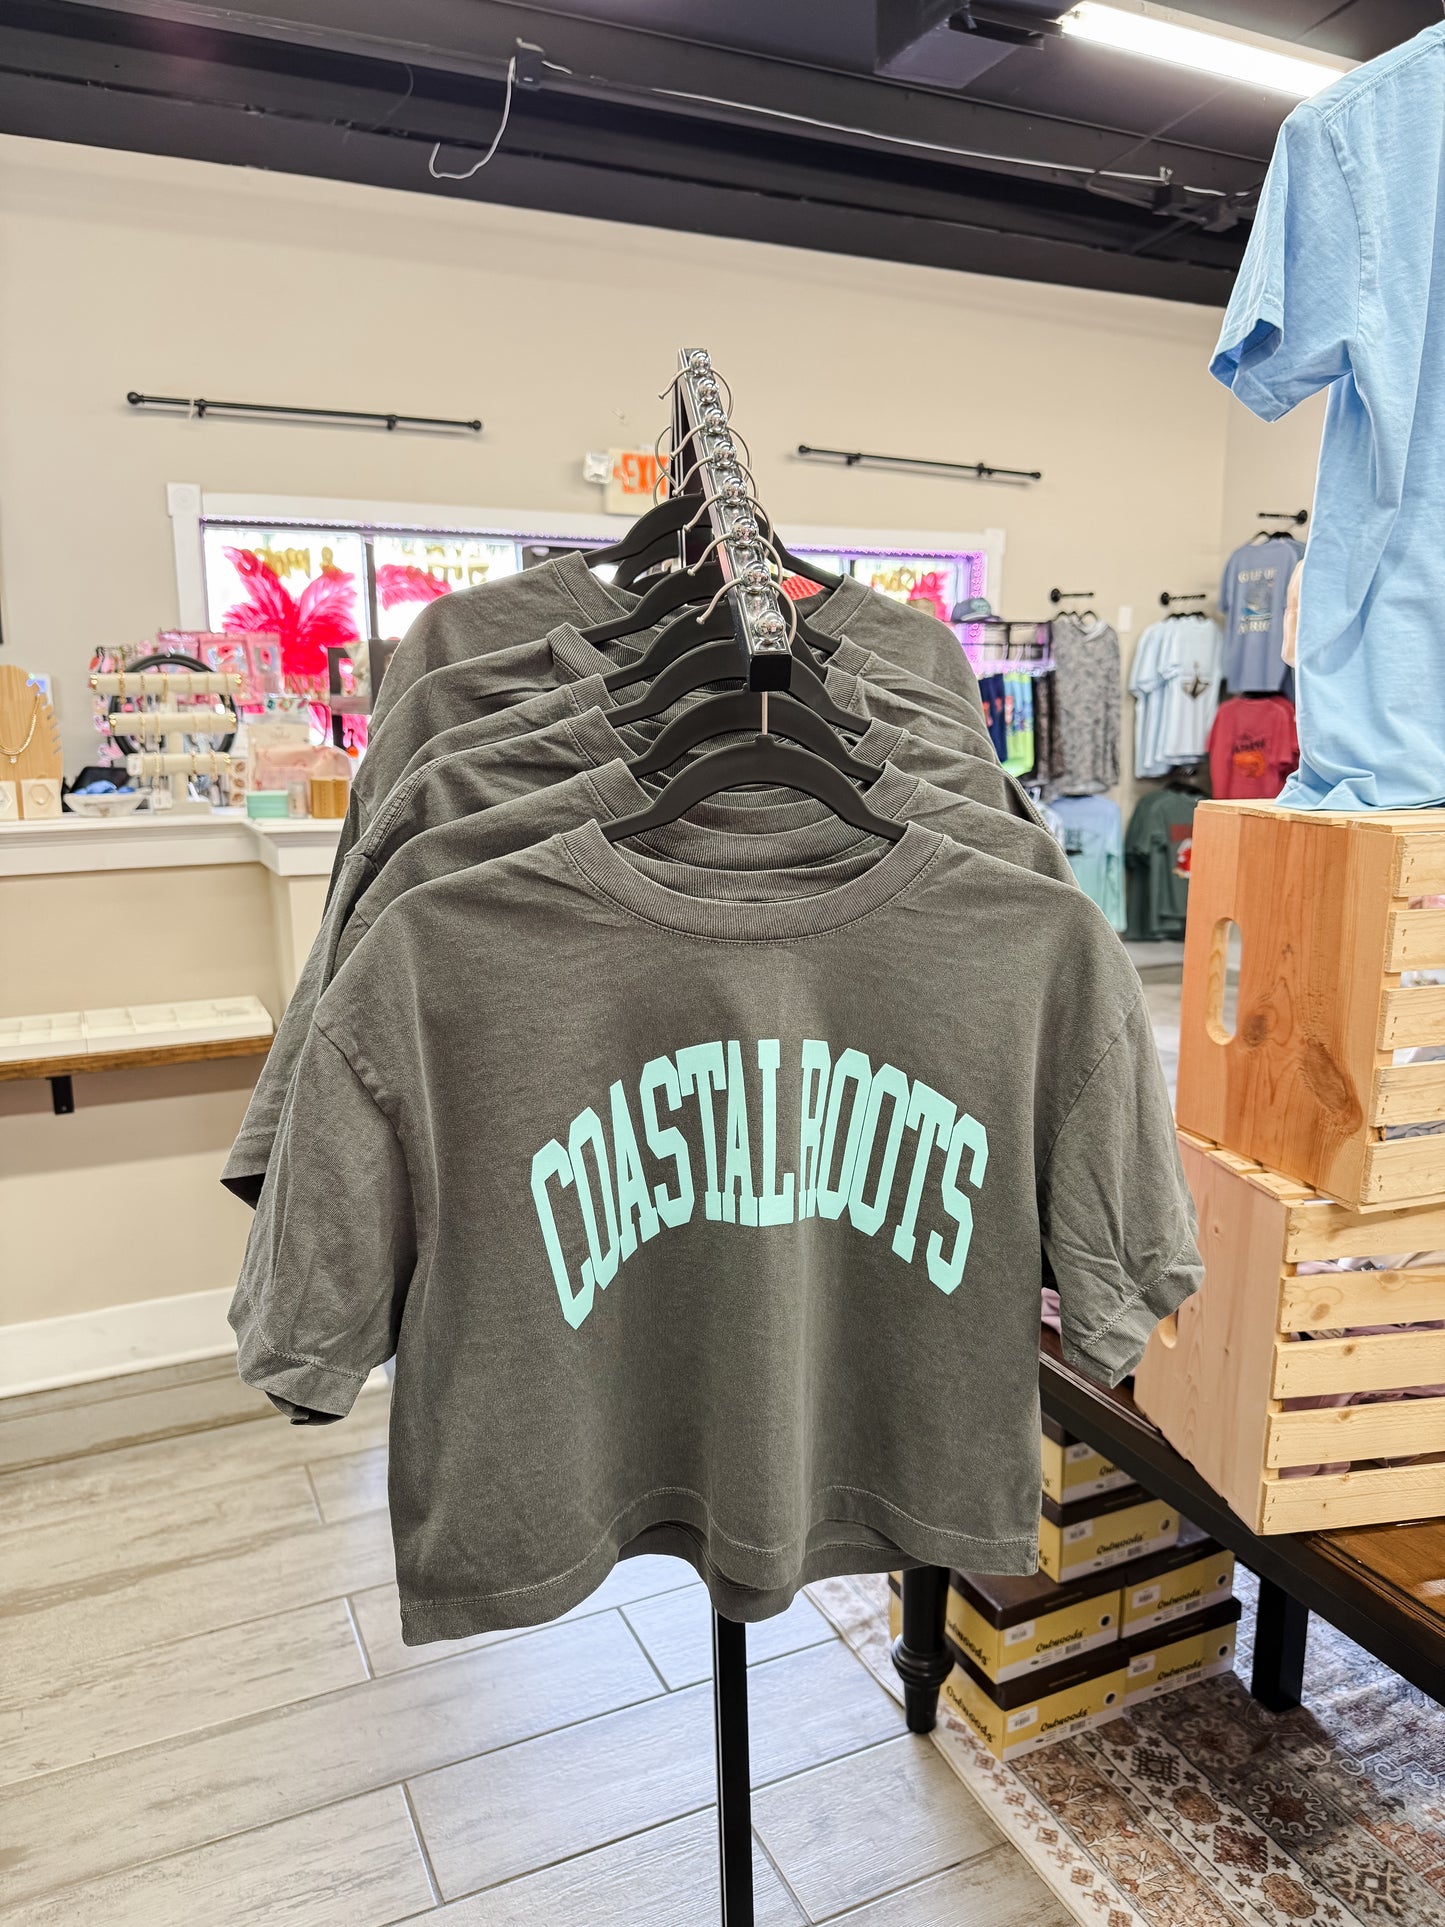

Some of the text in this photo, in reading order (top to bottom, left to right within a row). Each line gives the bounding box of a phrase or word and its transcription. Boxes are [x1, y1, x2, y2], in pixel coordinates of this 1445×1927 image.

[622, 453, 668, 495] EXIT
[531, 1038, 989, 1330] COASTAL ROOTS
